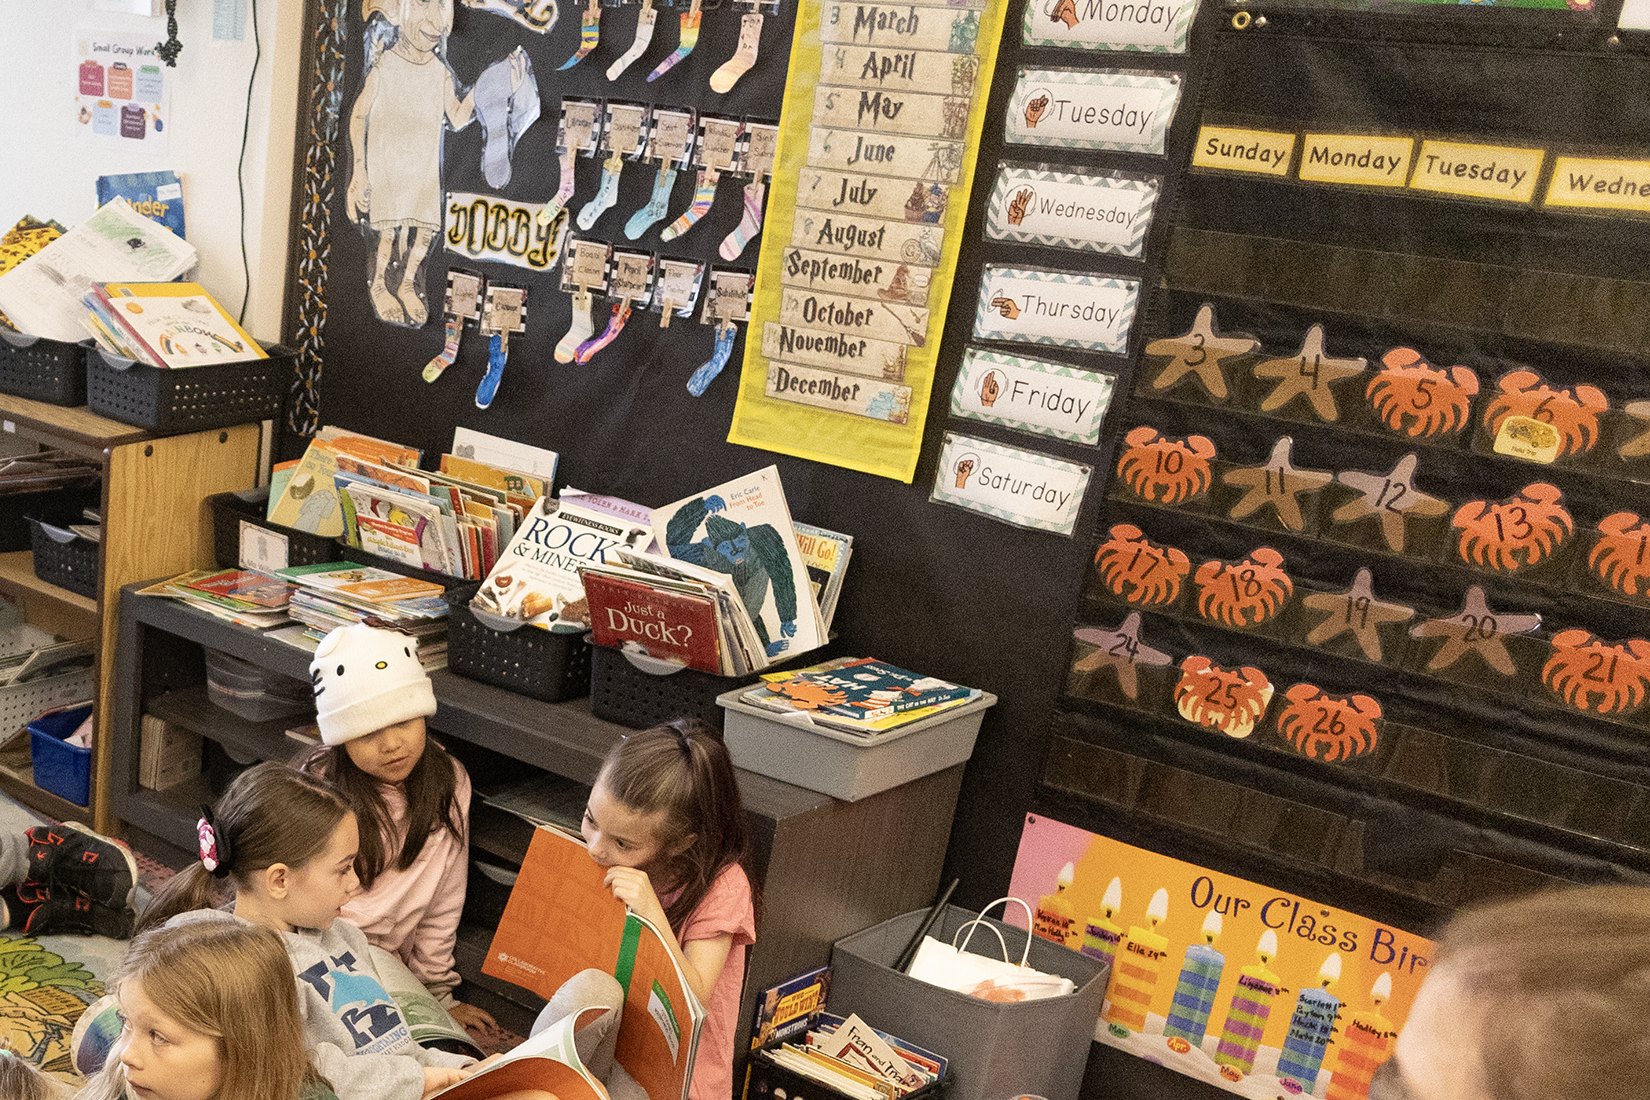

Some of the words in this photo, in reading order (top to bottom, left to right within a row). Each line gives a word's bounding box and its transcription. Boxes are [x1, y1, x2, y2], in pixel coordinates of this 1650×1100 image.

[853, 6, 919, 42] March
[1081, 0, 1180, 31] Monday
[92, 42, 110, 52] Small
[112, 44, 134, 56] Group
[859, 51, 916, 86] April
[857, 91, 904, 127] May
[1054, 99, 1152, 132] Tuesday
[847, 136, 895, 166] June
[1206, 138, 1285, 168] Sunday
[1309, 146, 1401, 174] Monday
[1426, 155, 1527, 190] Tuesday
[832, 178, 878, 206] July
[1039, 198, 1137, 229] Wednesday
[816, 218, 885, 251] August
[787, 249, 882, 287] September
[803, 297, 874, 327] October
[1022, 295, 1120, 327] Thursday
[779, 326, 867, 359] November
[775, 367, 861, 400] December
[1185, 333, 1207, 368] 3
[1298, 354, 1323, 390] 4
[1410, 378, 1438, 411] 5
[1011, 380, 1091, 417] Friday
[729, 498, 745, 509] From
[746, 493, 763, 503] Head
[730, 491, 742, 500] Eric
[744, 485, 760, 495] Carle
[755, 500, 765, 508] Toe
[977, 466, 1072, 510] Saturday
[1156, 450, 1184, 475] 10
[1264, 470, 1286, 496] 11
[1376, 480, 1405, 512] 12
[1493, 507, 1534, 541] 13
[513, 542, 529, 557] &
[523, 517, 634, 565] ROCK
[624, 601, 654, 617] Just
[657, 609, 666, 620] a
[1126, 547, 1161, 580] 17
[1229, 568, 1262, 601] 18
[1344, 596, 1370, 629] 19
[1462, 614, 1497, 642] 20
[1583, 651, 1618, 683] 21
[1108, 633, 1140, 661] 24
[1204, 679, 1239, 709] 25
[1312, 708, 1346, 736] 26
[1190, 876, 1251, 918] Our
[1260, 897, 1358, 954] Class
[1126, 941, 1145, 955] Ella
[1220, 1065, 1240, 1082] May
